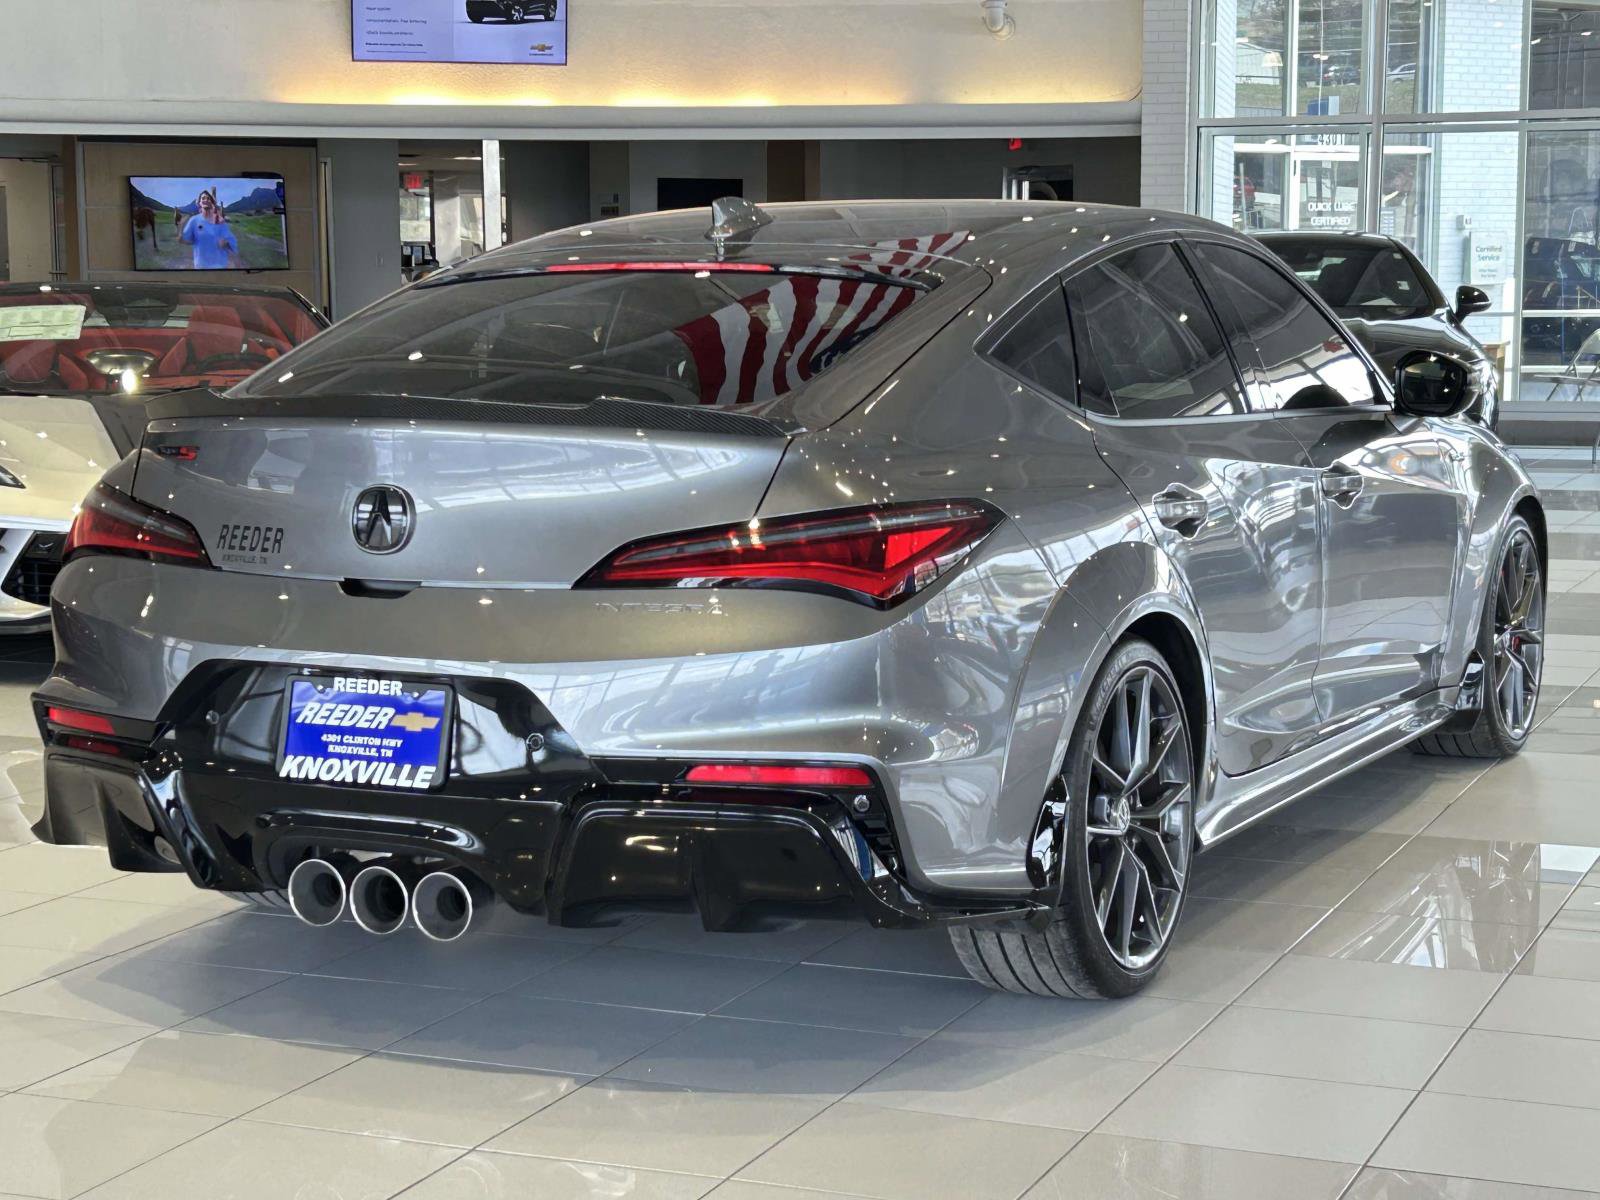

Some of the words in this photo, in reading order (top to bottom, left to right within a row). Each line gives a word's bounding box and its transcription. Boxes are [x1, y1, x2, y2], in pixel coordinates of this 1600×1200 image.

[1308, 202, 1332, 212] QUICK
[1310, 216, 1351, 226] CERTIFIED
[216, 524, 284, 553] REEDER
[333, 677, 403, 697] REEDER
[295, 702, 396, 730] REEDER
[342, 735, 382, 746] CLINTON
[382, 738, 403, 747] HWY
[380, 748, 394, 758] TN
[279, 755, 436, 789] KNOXVILLE
